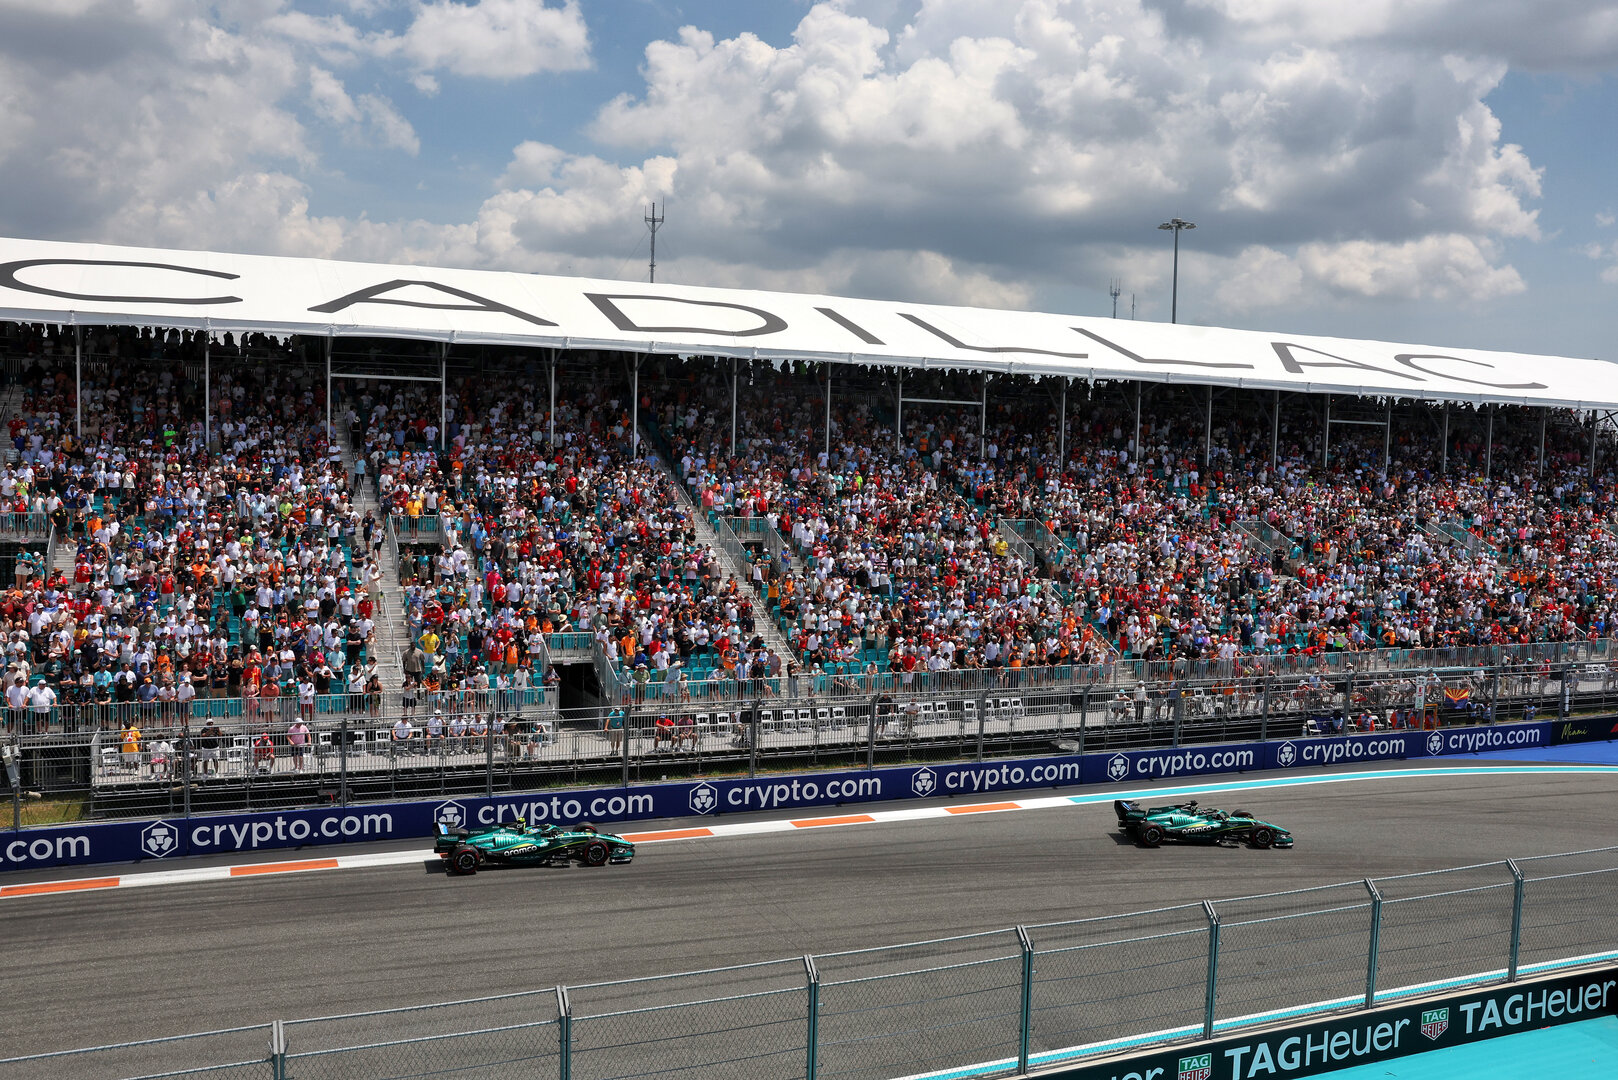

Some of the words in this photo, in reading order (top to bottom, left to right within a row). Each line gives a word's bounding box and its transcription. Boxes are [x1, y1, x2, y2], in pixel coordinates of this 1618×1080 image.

[0, 258, 1548, 389] CADILLAC
[1449, 728, 1541, 751] crypto.com
[1561, 722, 1588, 740] Miami
[1303, 738, 1405, 763] crypto.com
[1137, 750, 1254, 777] crypto.com
[945, 763, 1080, 790] crypto.com
[727, 777, 882, 808] crypto.com
[478, 794, 654, 825] crypto.com
[191, 813, 393, 849] crypto.com
[1181, 826, 1212, 834] aramco
[503, 845, 538, 857] aramco
[1424, 1010, 1447, 1023] TAG
[1422, 1021, 1447, 1038] HEUER
[1181, 1056, 1209, 1070] TAG
